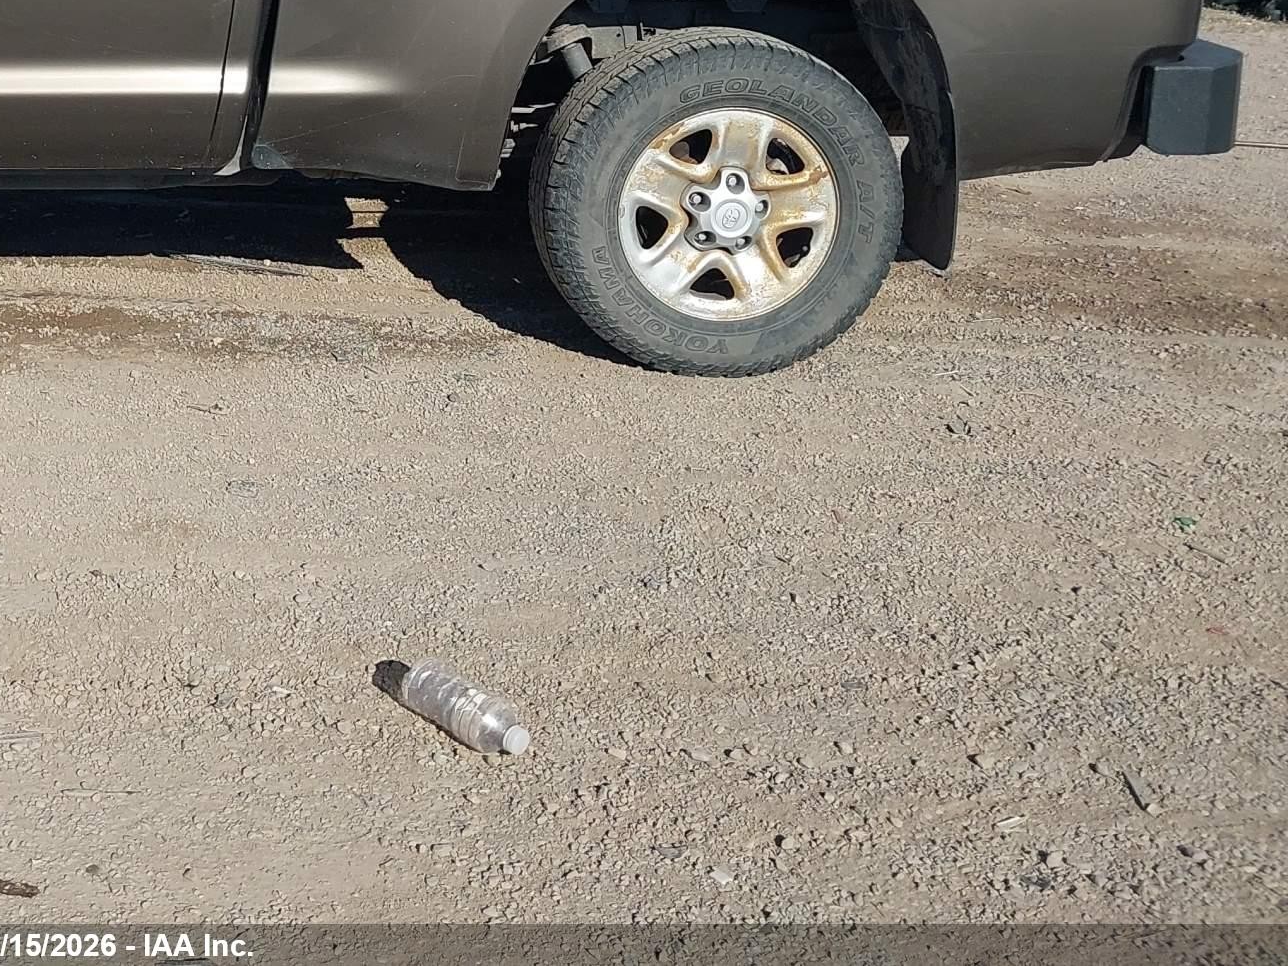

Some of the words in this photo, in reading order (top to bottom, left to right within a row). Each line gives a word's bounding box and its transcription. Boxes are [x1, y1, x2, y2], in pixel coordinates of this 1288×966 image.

[679, 77, 865, 168] GEOLANDAR
[856, 178, 876, 245] A/T
[591, 245, 729, 355] YOKOHAMA
